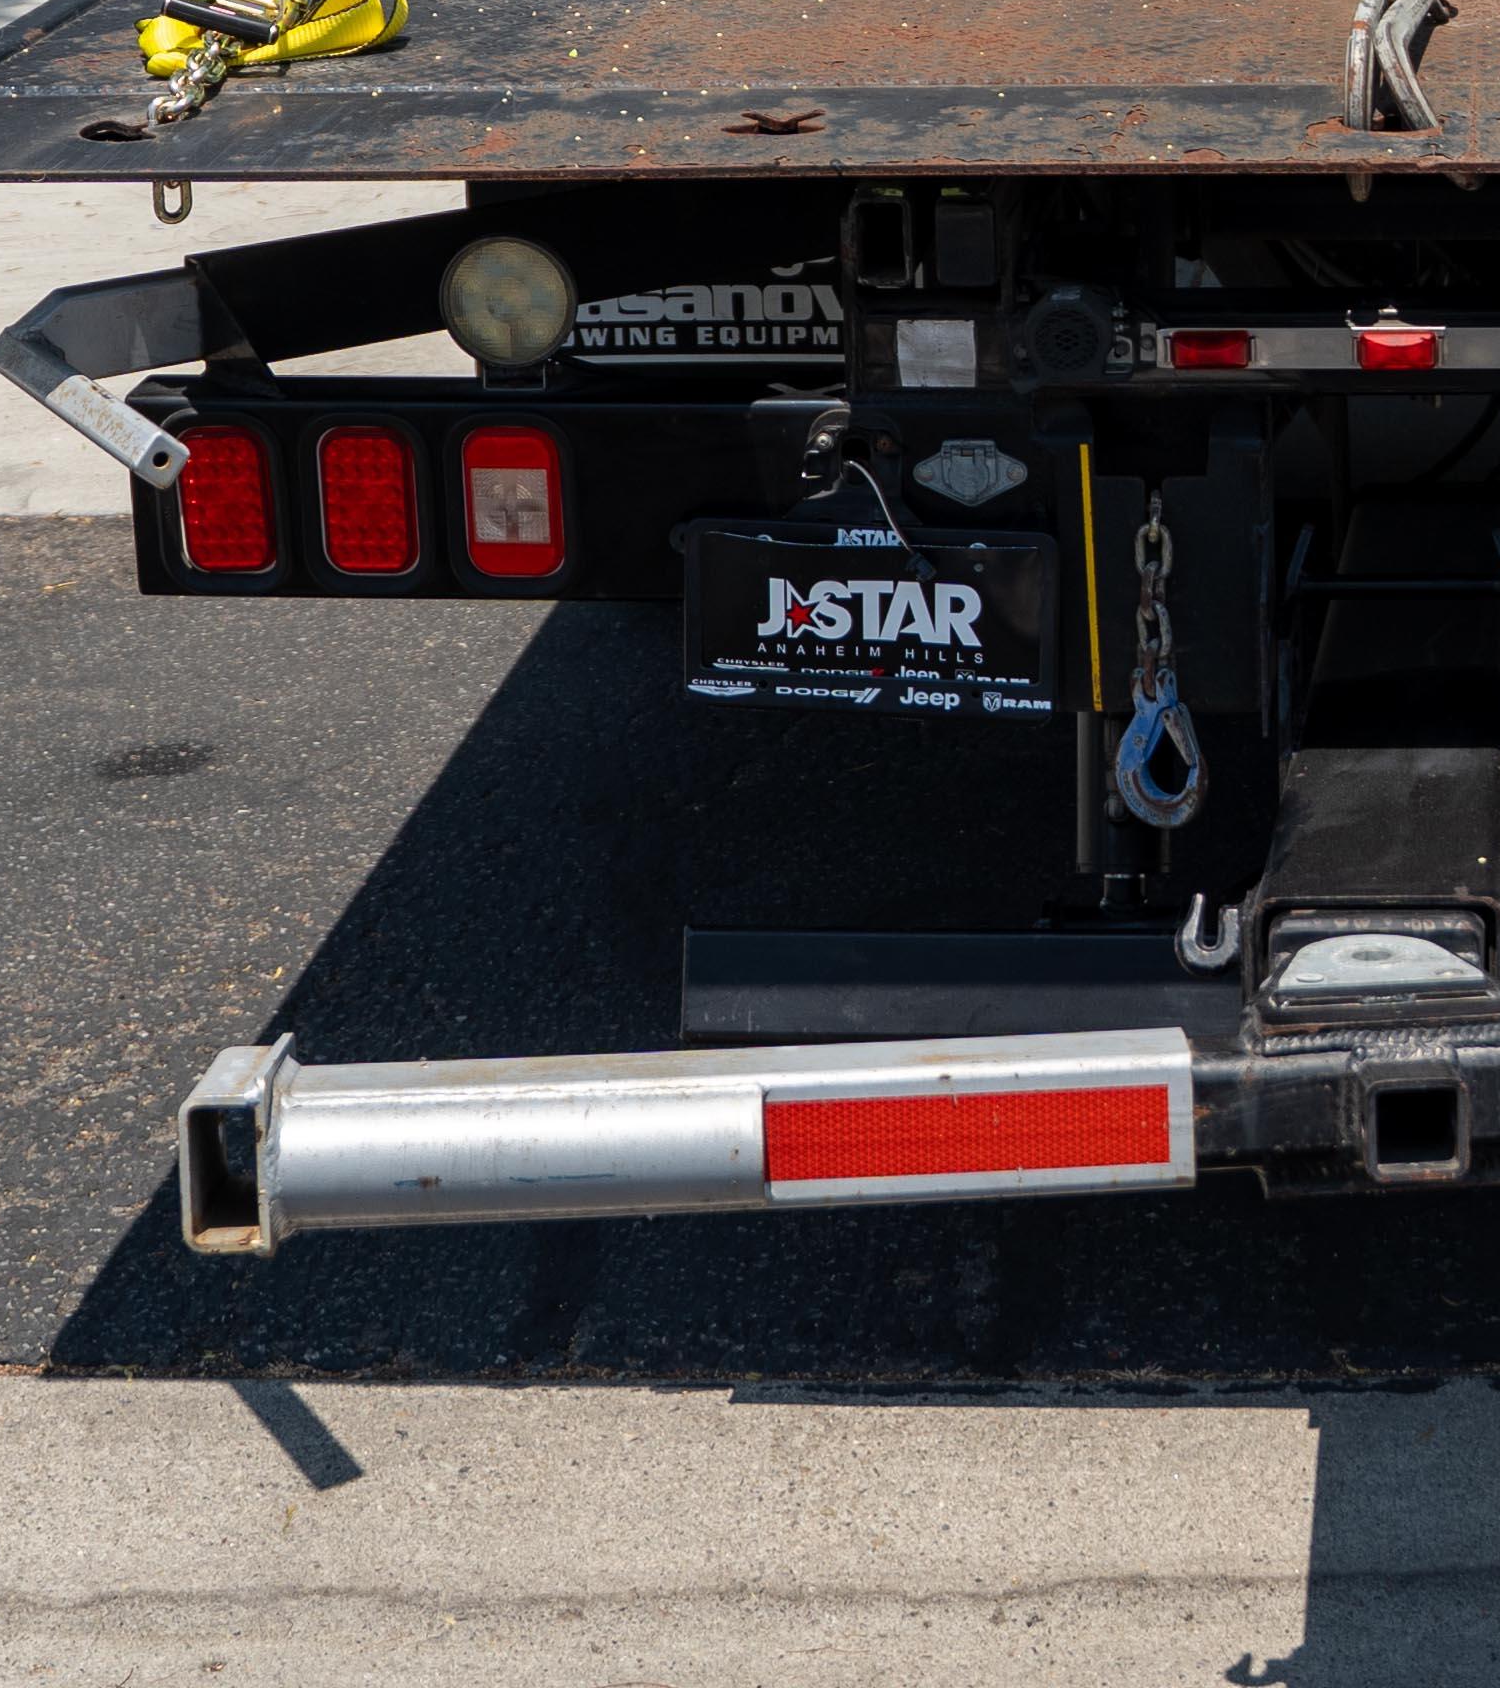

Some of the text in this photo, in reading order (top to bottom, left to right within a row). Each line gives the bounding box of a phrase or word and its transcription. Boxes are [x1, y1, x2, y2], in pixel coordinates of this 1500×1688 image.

[757, 642, 984, 664] ANAHEIM HILLS
[717, 657, 785, 667] CHRYSLER
[691, 678, 752, 687] CHRYSLER
[775, 686, 864, 699] DODGE
[900, 686, 960, 710] Jeep
[1002, 698, 1052, 710] RAM
